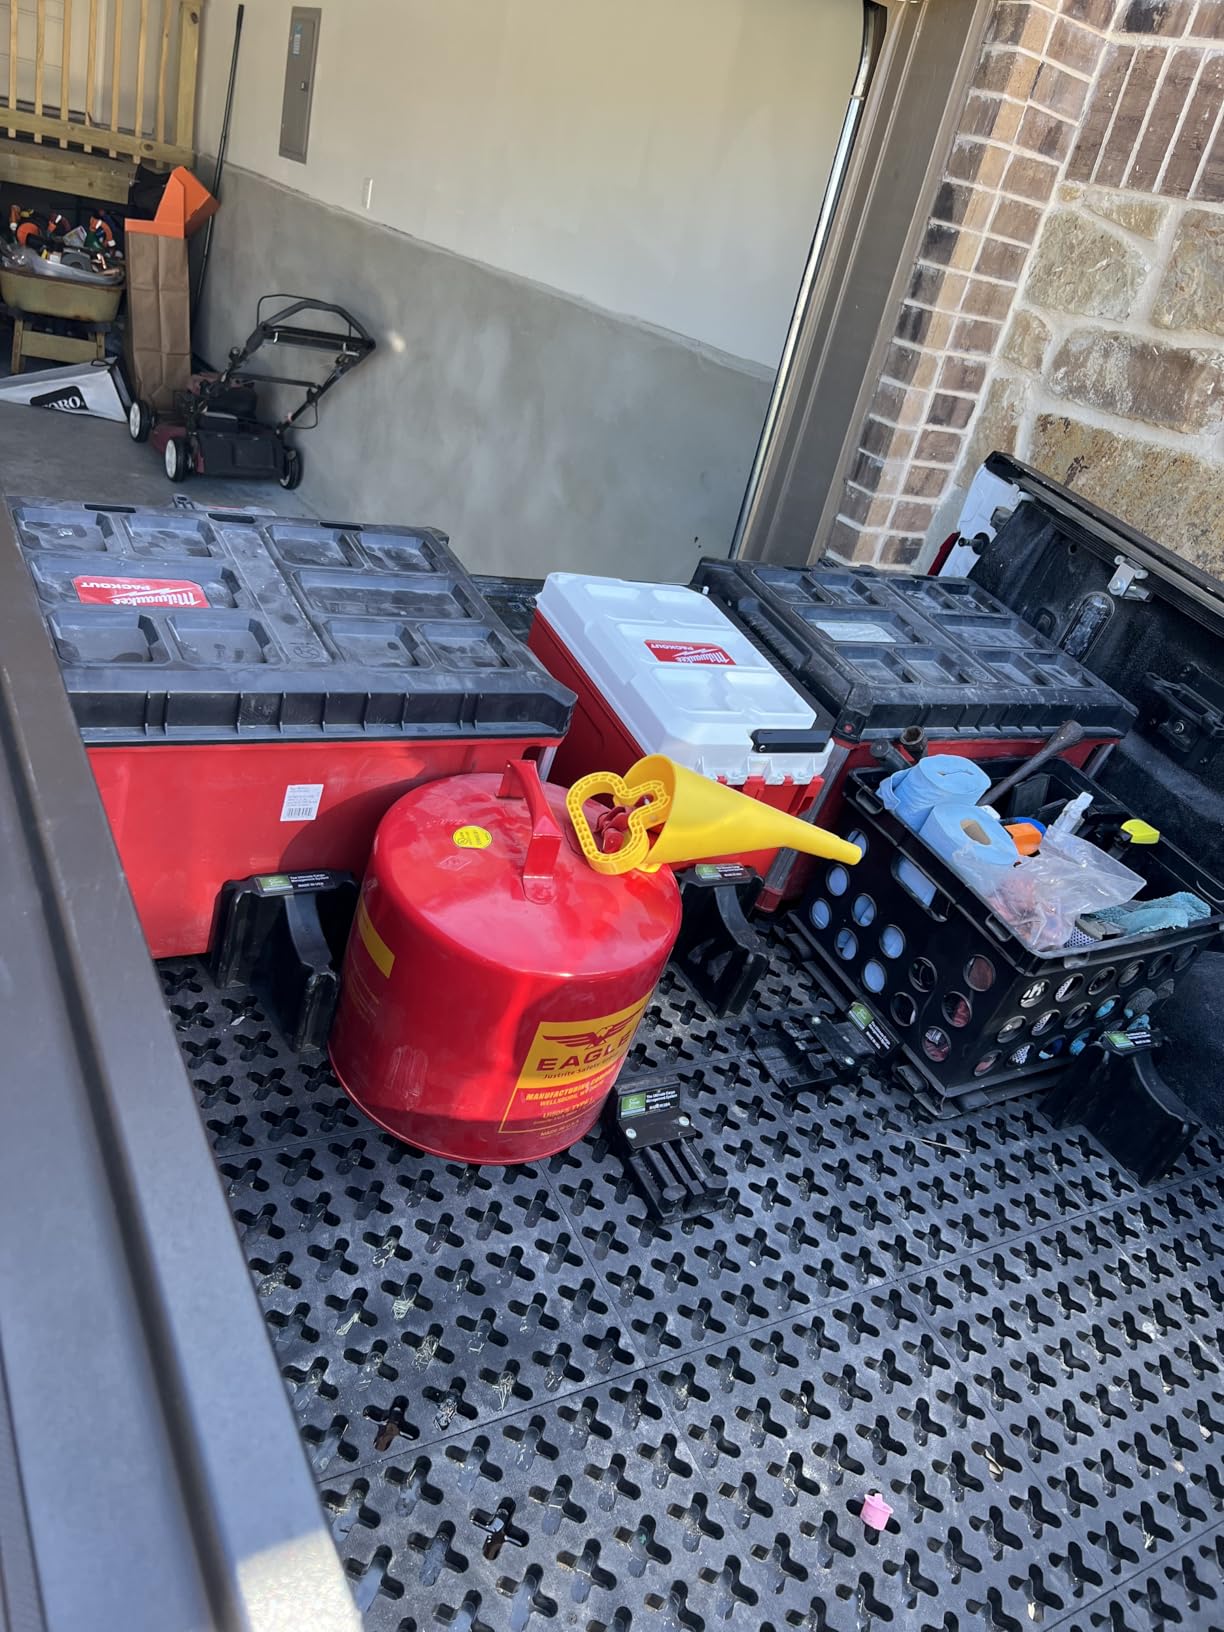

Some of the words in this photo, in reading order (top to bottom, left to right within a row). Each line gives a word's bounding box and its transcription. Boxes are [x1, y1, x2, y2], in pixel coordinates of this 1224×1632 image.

[80, 582, 150, 591] PACKOUT
[112, 592, 201, 606] Milwaukee
[674, 652, 730, 664] Milwaukee
[536, 1029, 632, 1071] EAGLE
